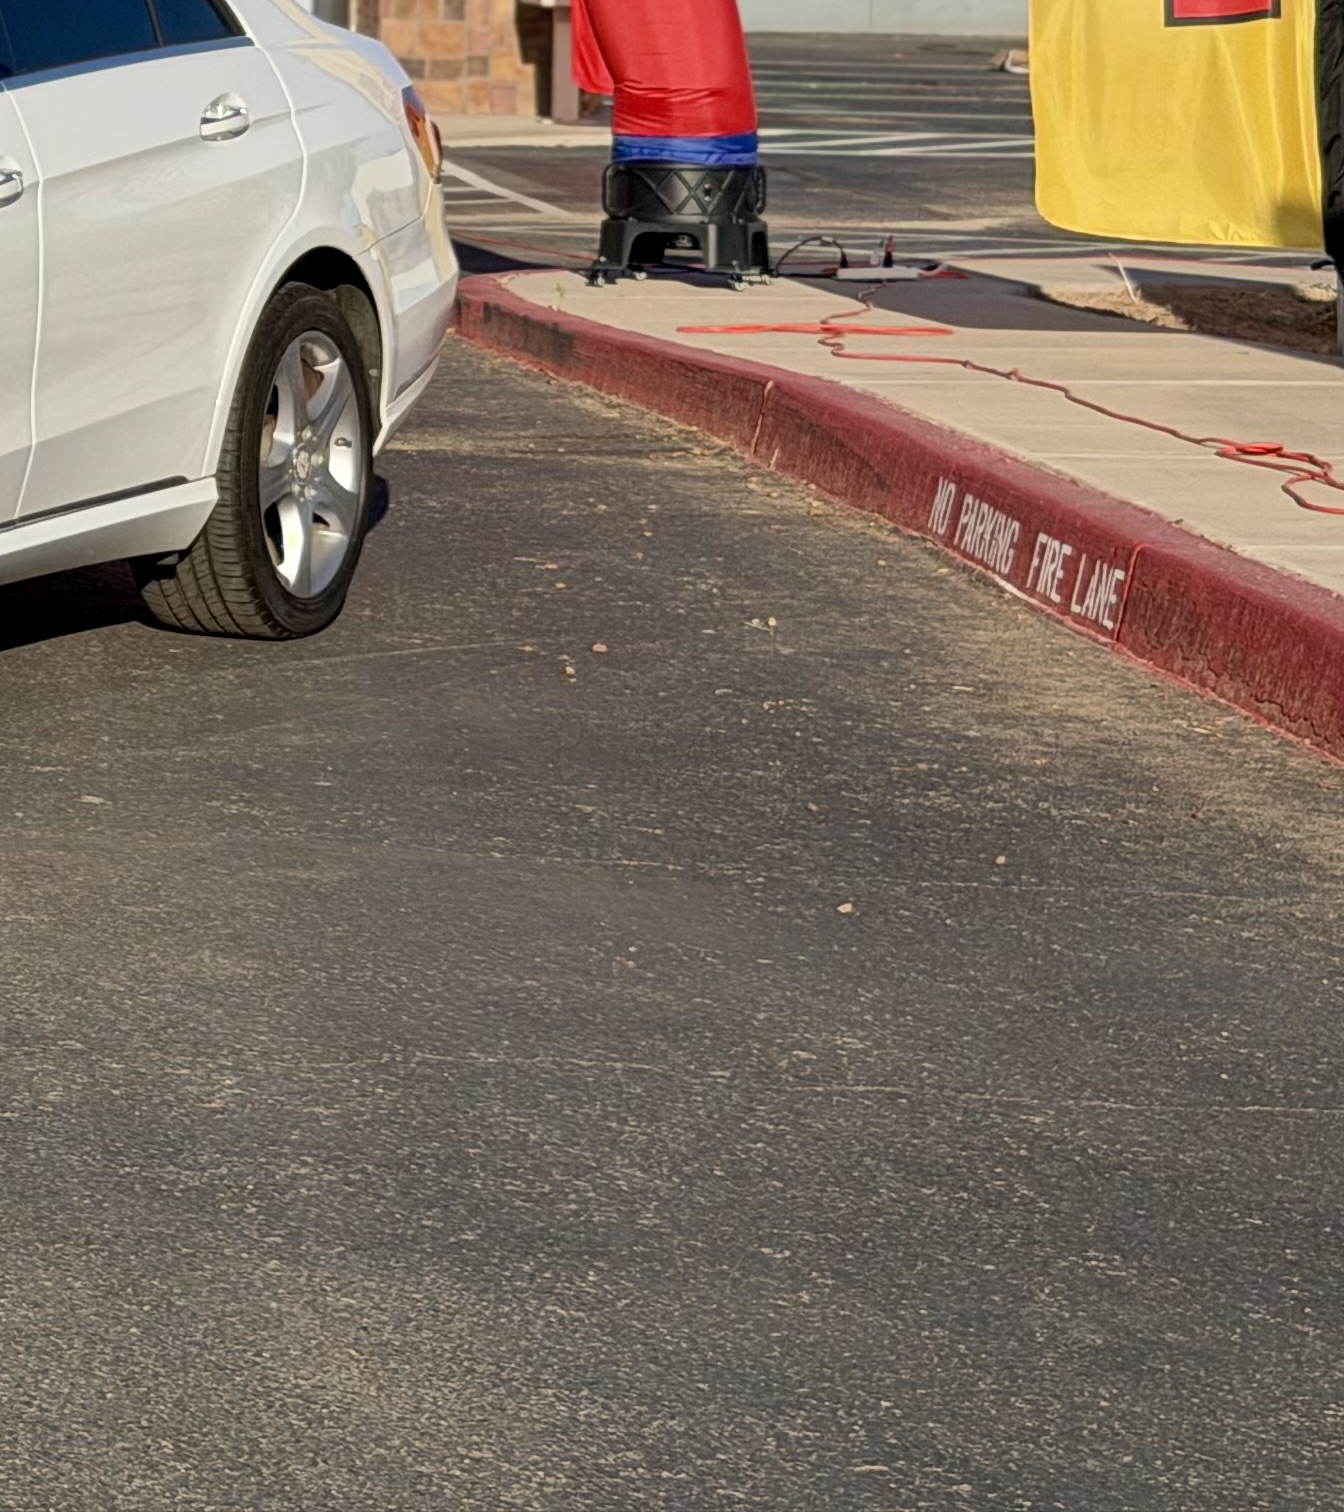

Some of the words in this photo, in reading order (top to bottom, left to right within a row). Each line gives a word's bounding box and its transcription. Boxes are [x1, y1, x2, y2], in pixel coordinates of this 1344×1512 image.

[927, 475, 957, 537] NO
[953, 493, 1021, 575] PARKING
[1025, 531, 1073, 604] FIRE
[1069, 553, 1125, 630] LANE
